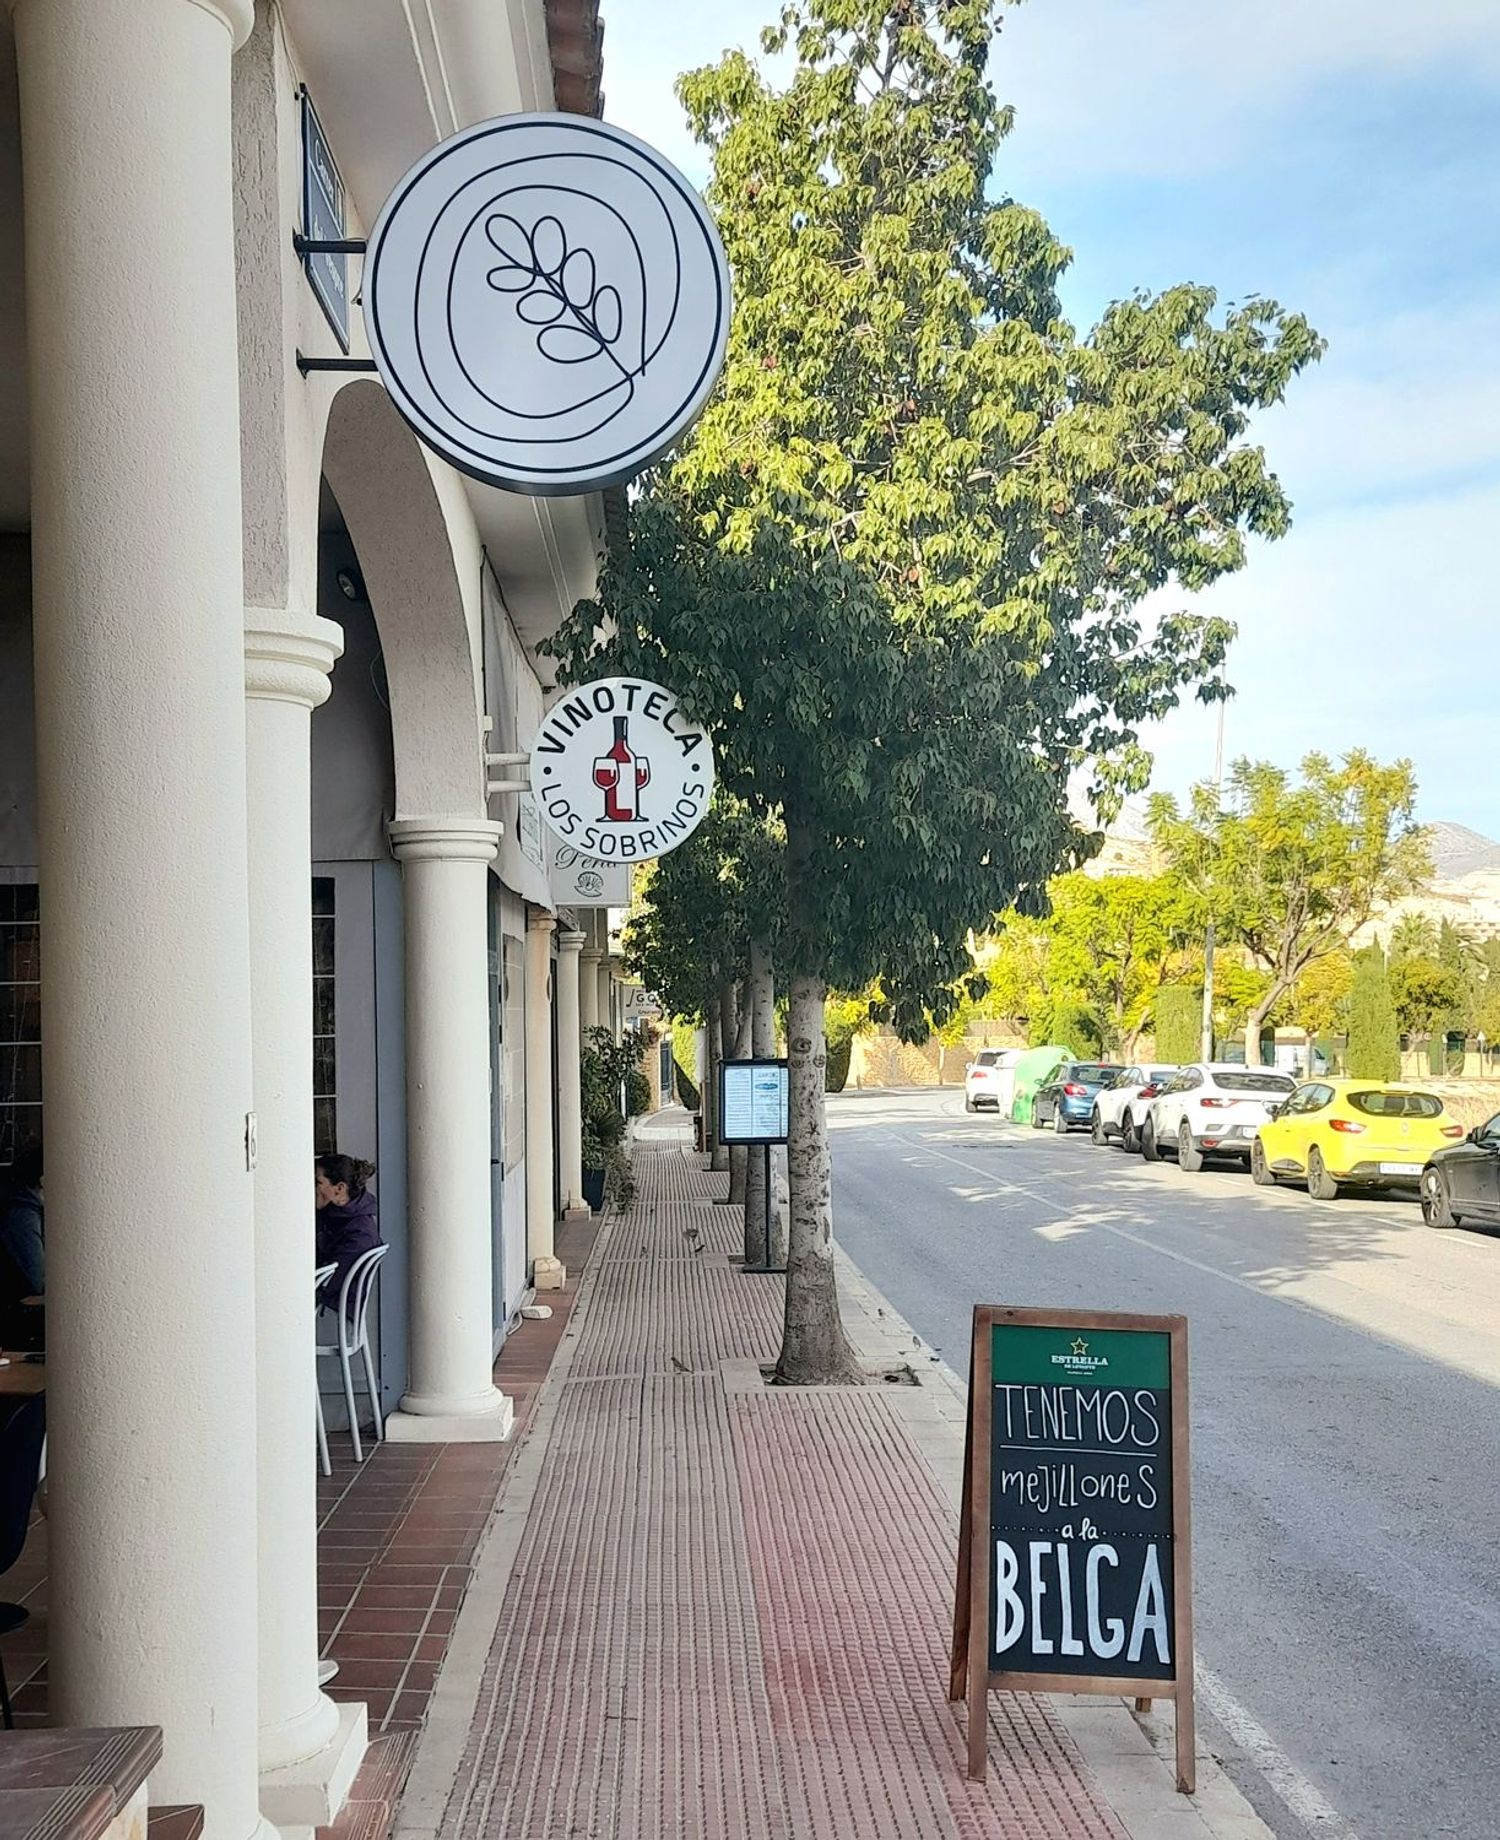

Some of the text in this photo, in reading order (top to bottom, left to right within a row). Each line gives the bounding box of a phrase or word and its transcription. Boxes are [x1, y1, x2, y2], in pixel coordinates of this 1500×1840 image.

[537, 684, 703, 757] VINOTECA
[541, 783, 583, 835] LOS
[580, 782, 705, 857] SOBRINOS
[1051, 1355, 1109, 1365] ESTRELLA
[995, 1384, 1160, 1447] TENEMOS
[1061, 1517, 1099, 1541] a la
[995, 1541, 1171, 1665] BELGA
